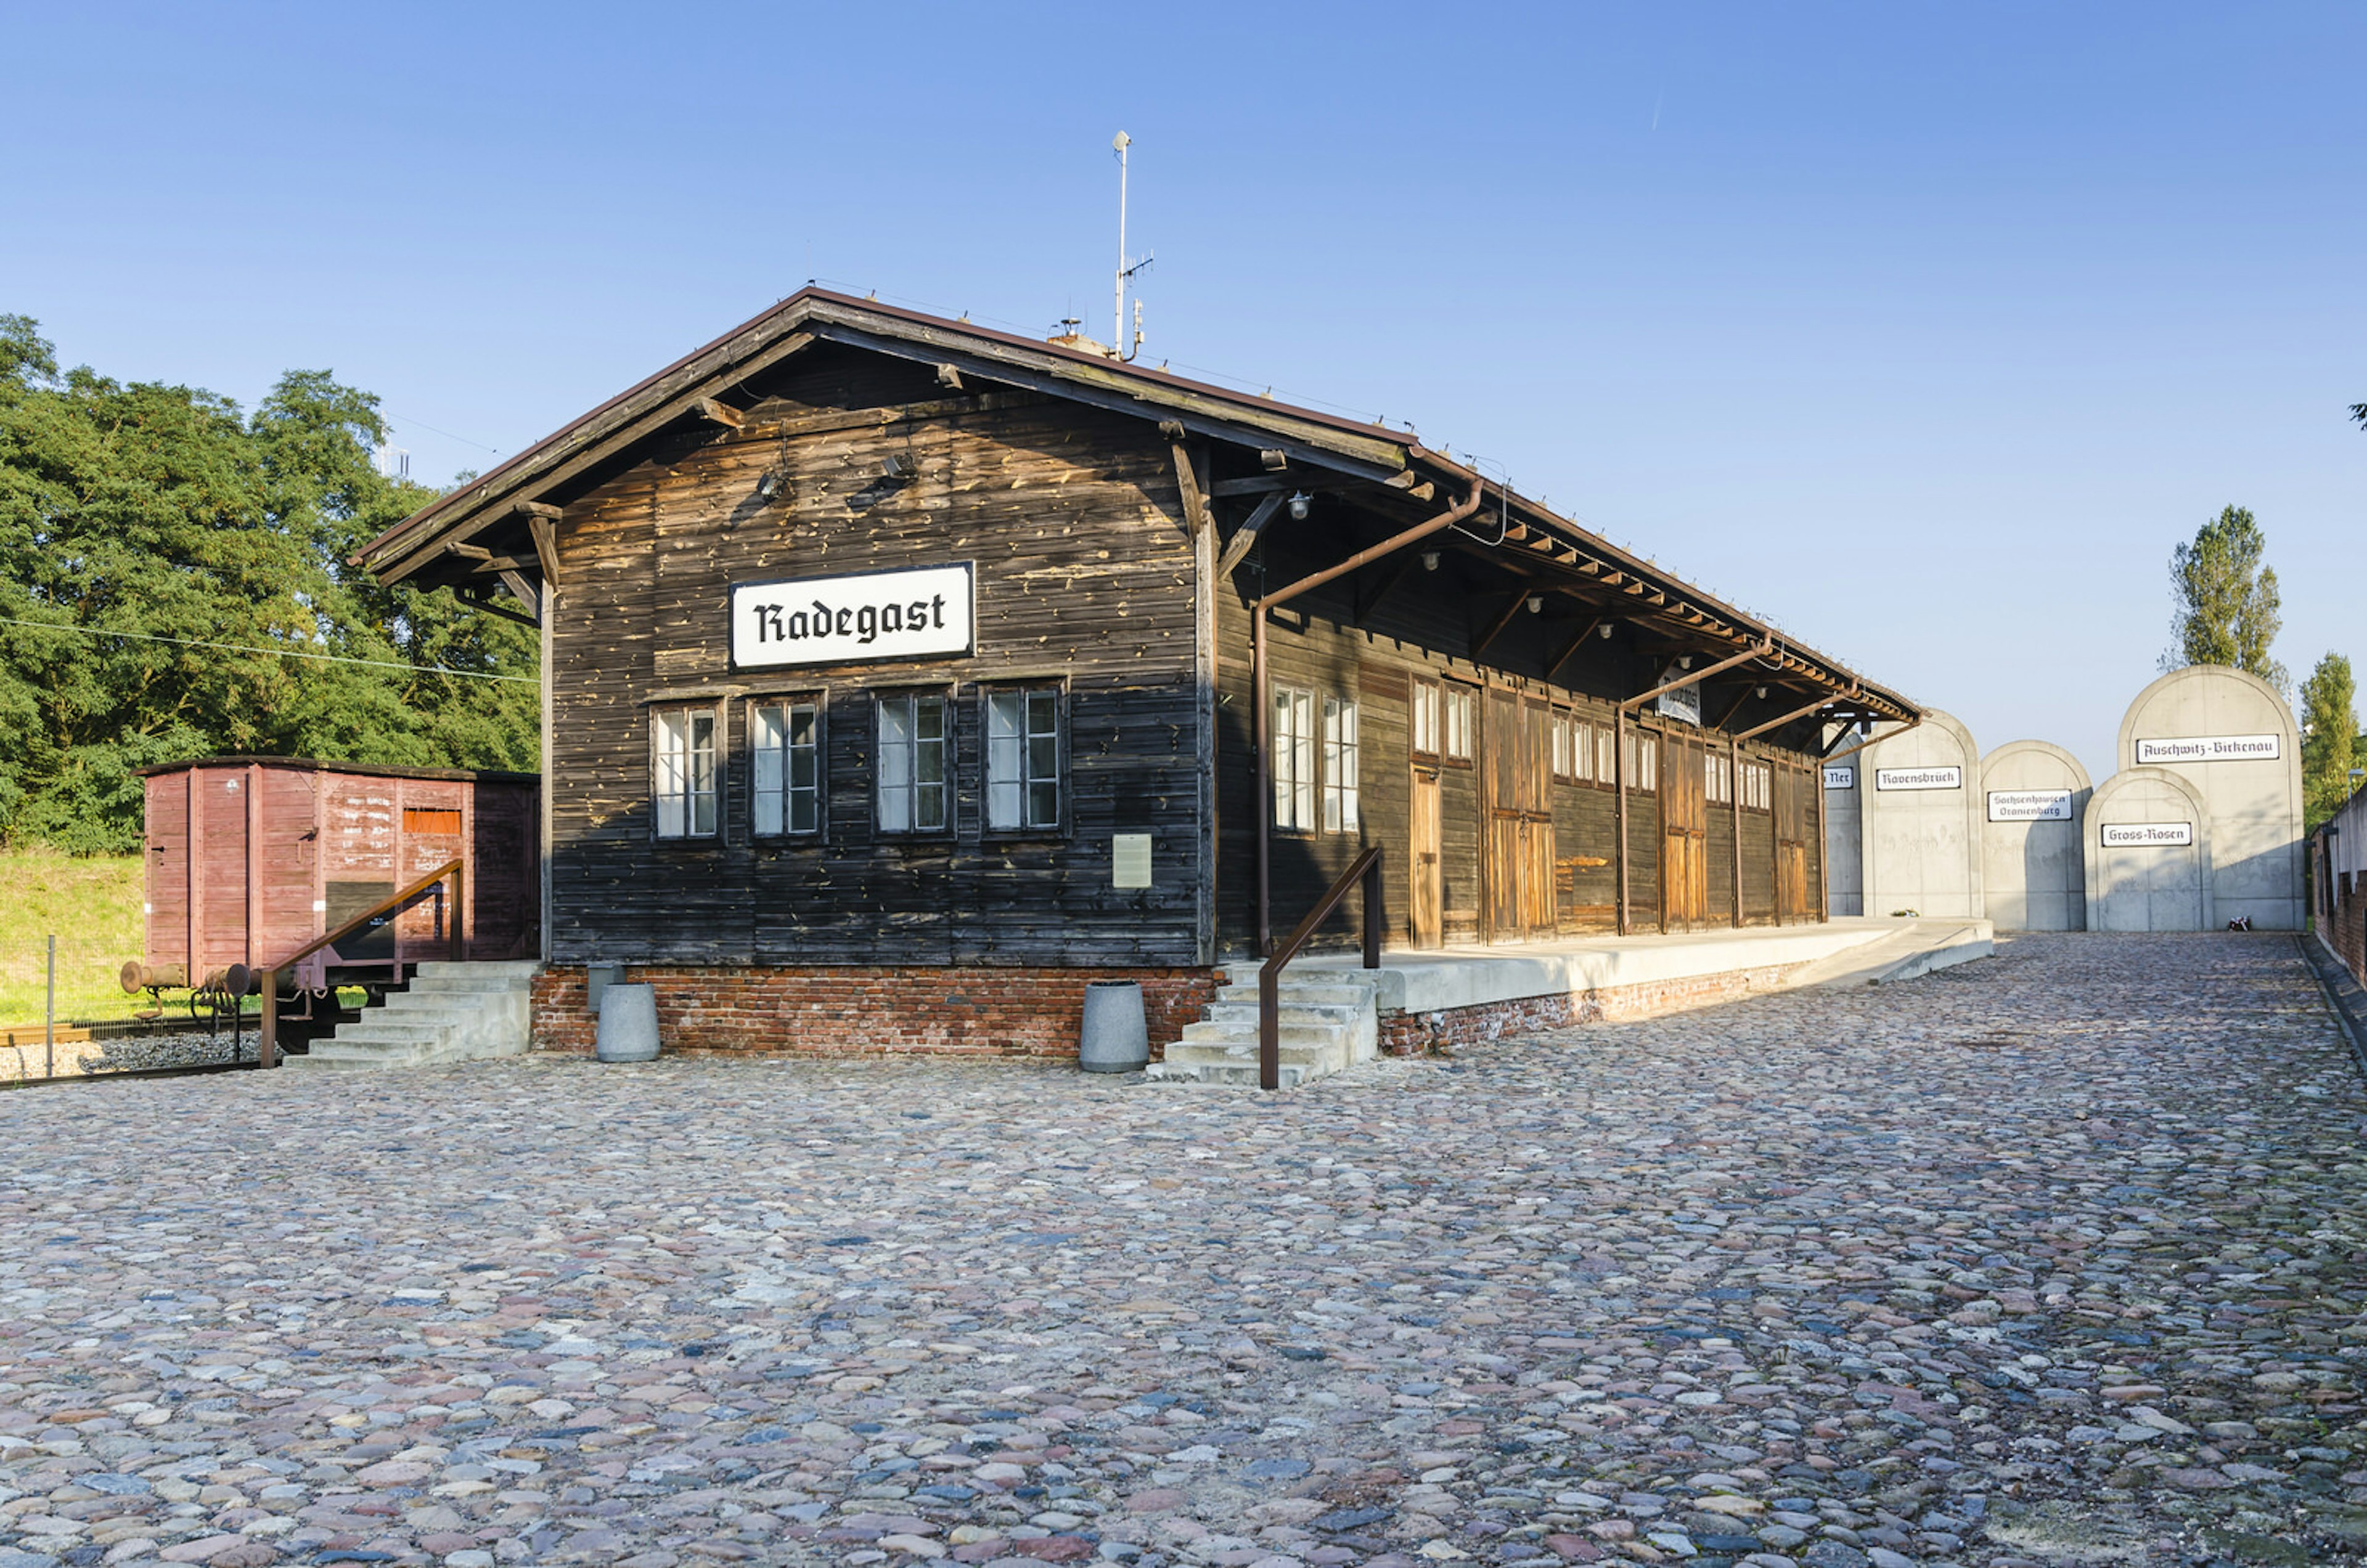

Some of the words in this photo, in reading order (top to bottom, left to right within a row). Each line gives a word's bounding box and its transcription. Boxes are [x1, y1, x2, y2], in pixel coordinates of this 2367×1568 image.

[753, 594, 946, 643] Radegast
[1883, 771, 1954, 784] Ravensbrück
[1994, 794, 2066, 805] Sachsenhausen
[2000, 806, 2059, 816] Oranienburg
